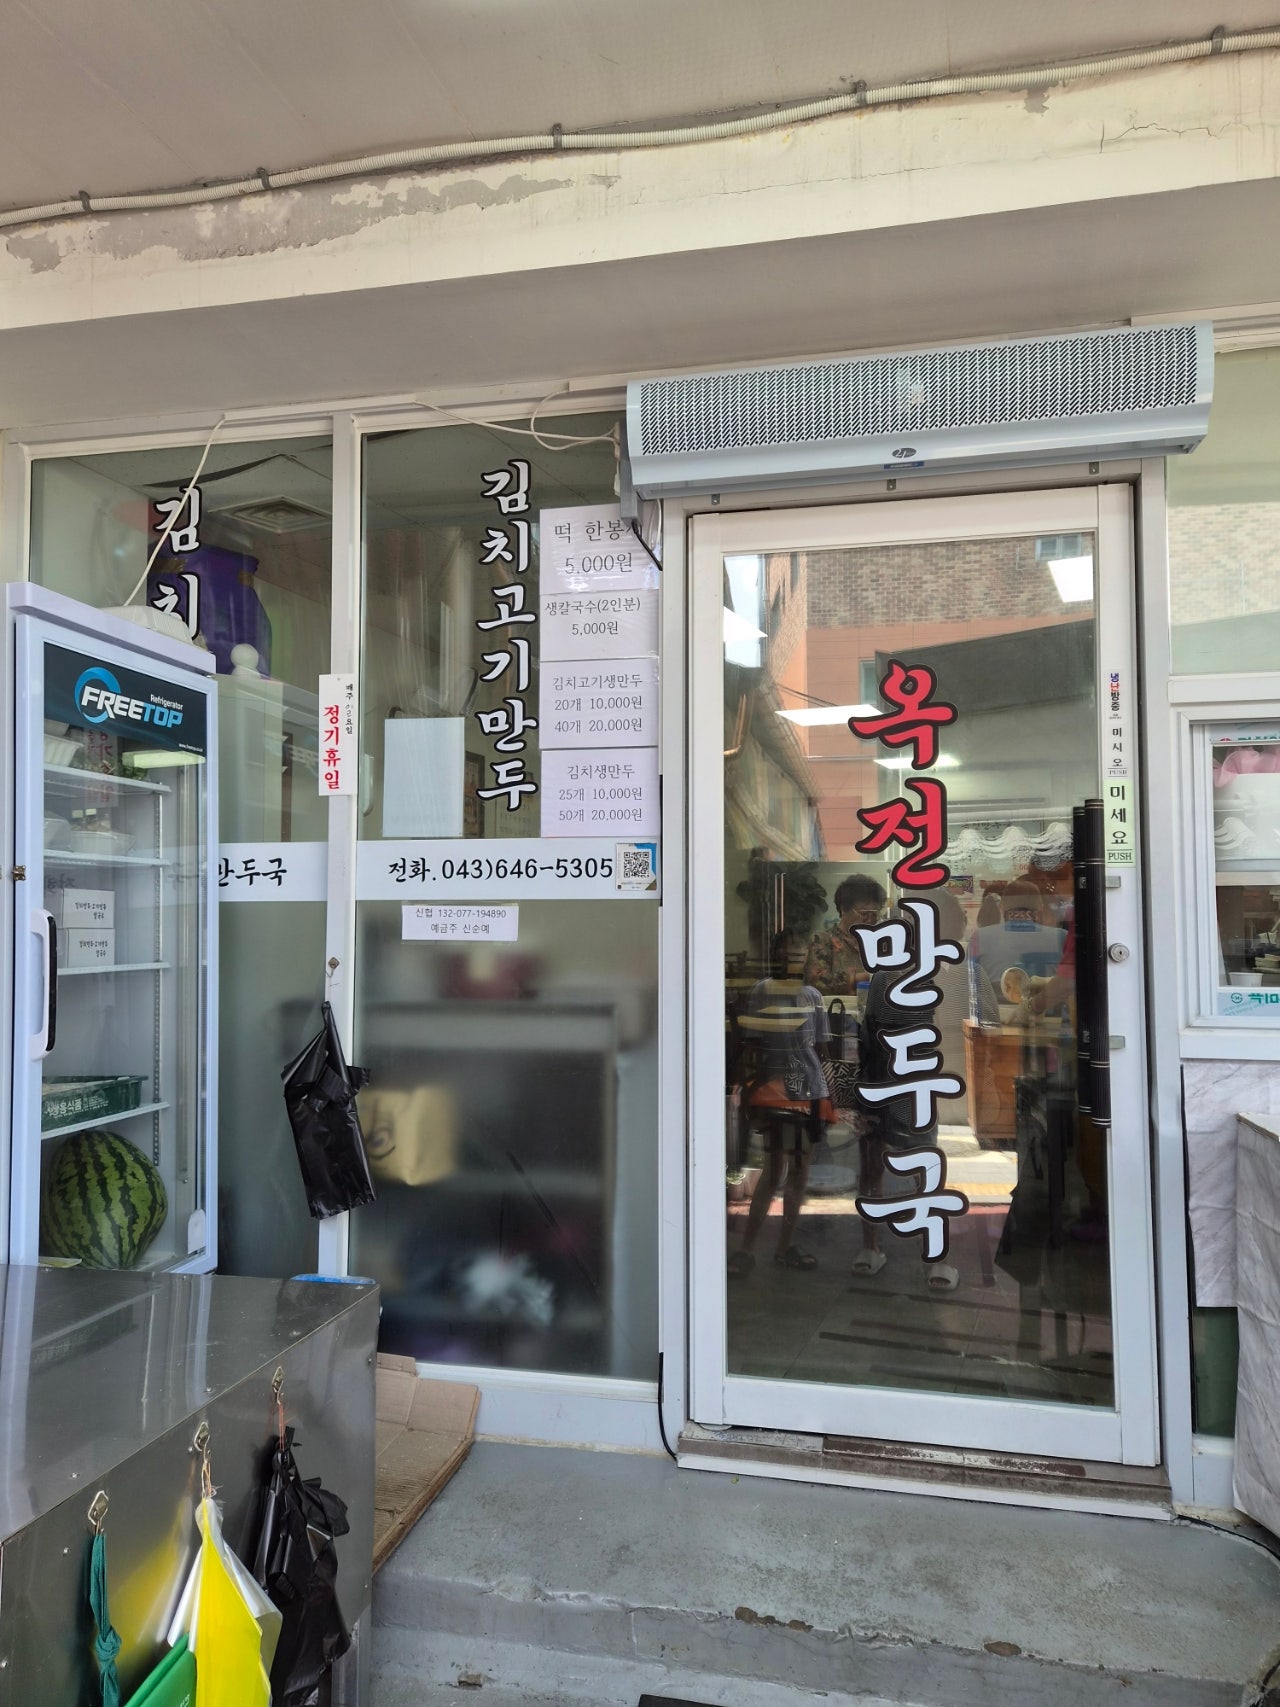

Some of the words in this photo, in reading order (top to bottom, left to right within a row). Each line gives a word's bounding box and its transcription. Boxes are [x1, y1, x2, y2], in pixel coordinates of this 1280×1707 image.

[554, 522, 572, 544] 떡
[584, 519, 634, 542] 한봉
[544, 597, 641, 616] 생칼국수(2인분)
[476, 458, 538, 811] 김치고기만두
[552, 674, 643, 691] 김치고기생만두
[345, 683, 353, 701] 매주
[1110, 672, 1120, 712] 냉난방중
[81, 685, 183, 728] FREETOP
[150, 693, 184, 711] Refrigerator
[554, 698, 582, 712] 20개
[554, 720, 582, 733] 40개
[323, 704, 341, 790] 정기휴일
[1112, 727, 1123, 767] 미시오
[567, 764, 635, 780] 김치생만두
[559, 788, 585, 801] 25개
[559, 809, 585, 823] 50개
[1110, 785, 1129, 845] 미세요
[1108, 852, 1132, 861] PUSH
[415, 907, 434, 919] 신협
[437, 909, 507, 919] 132-077-194890
[430, 923, 458, 935] 예금주
[462, 923, 491, 935] 신순예
